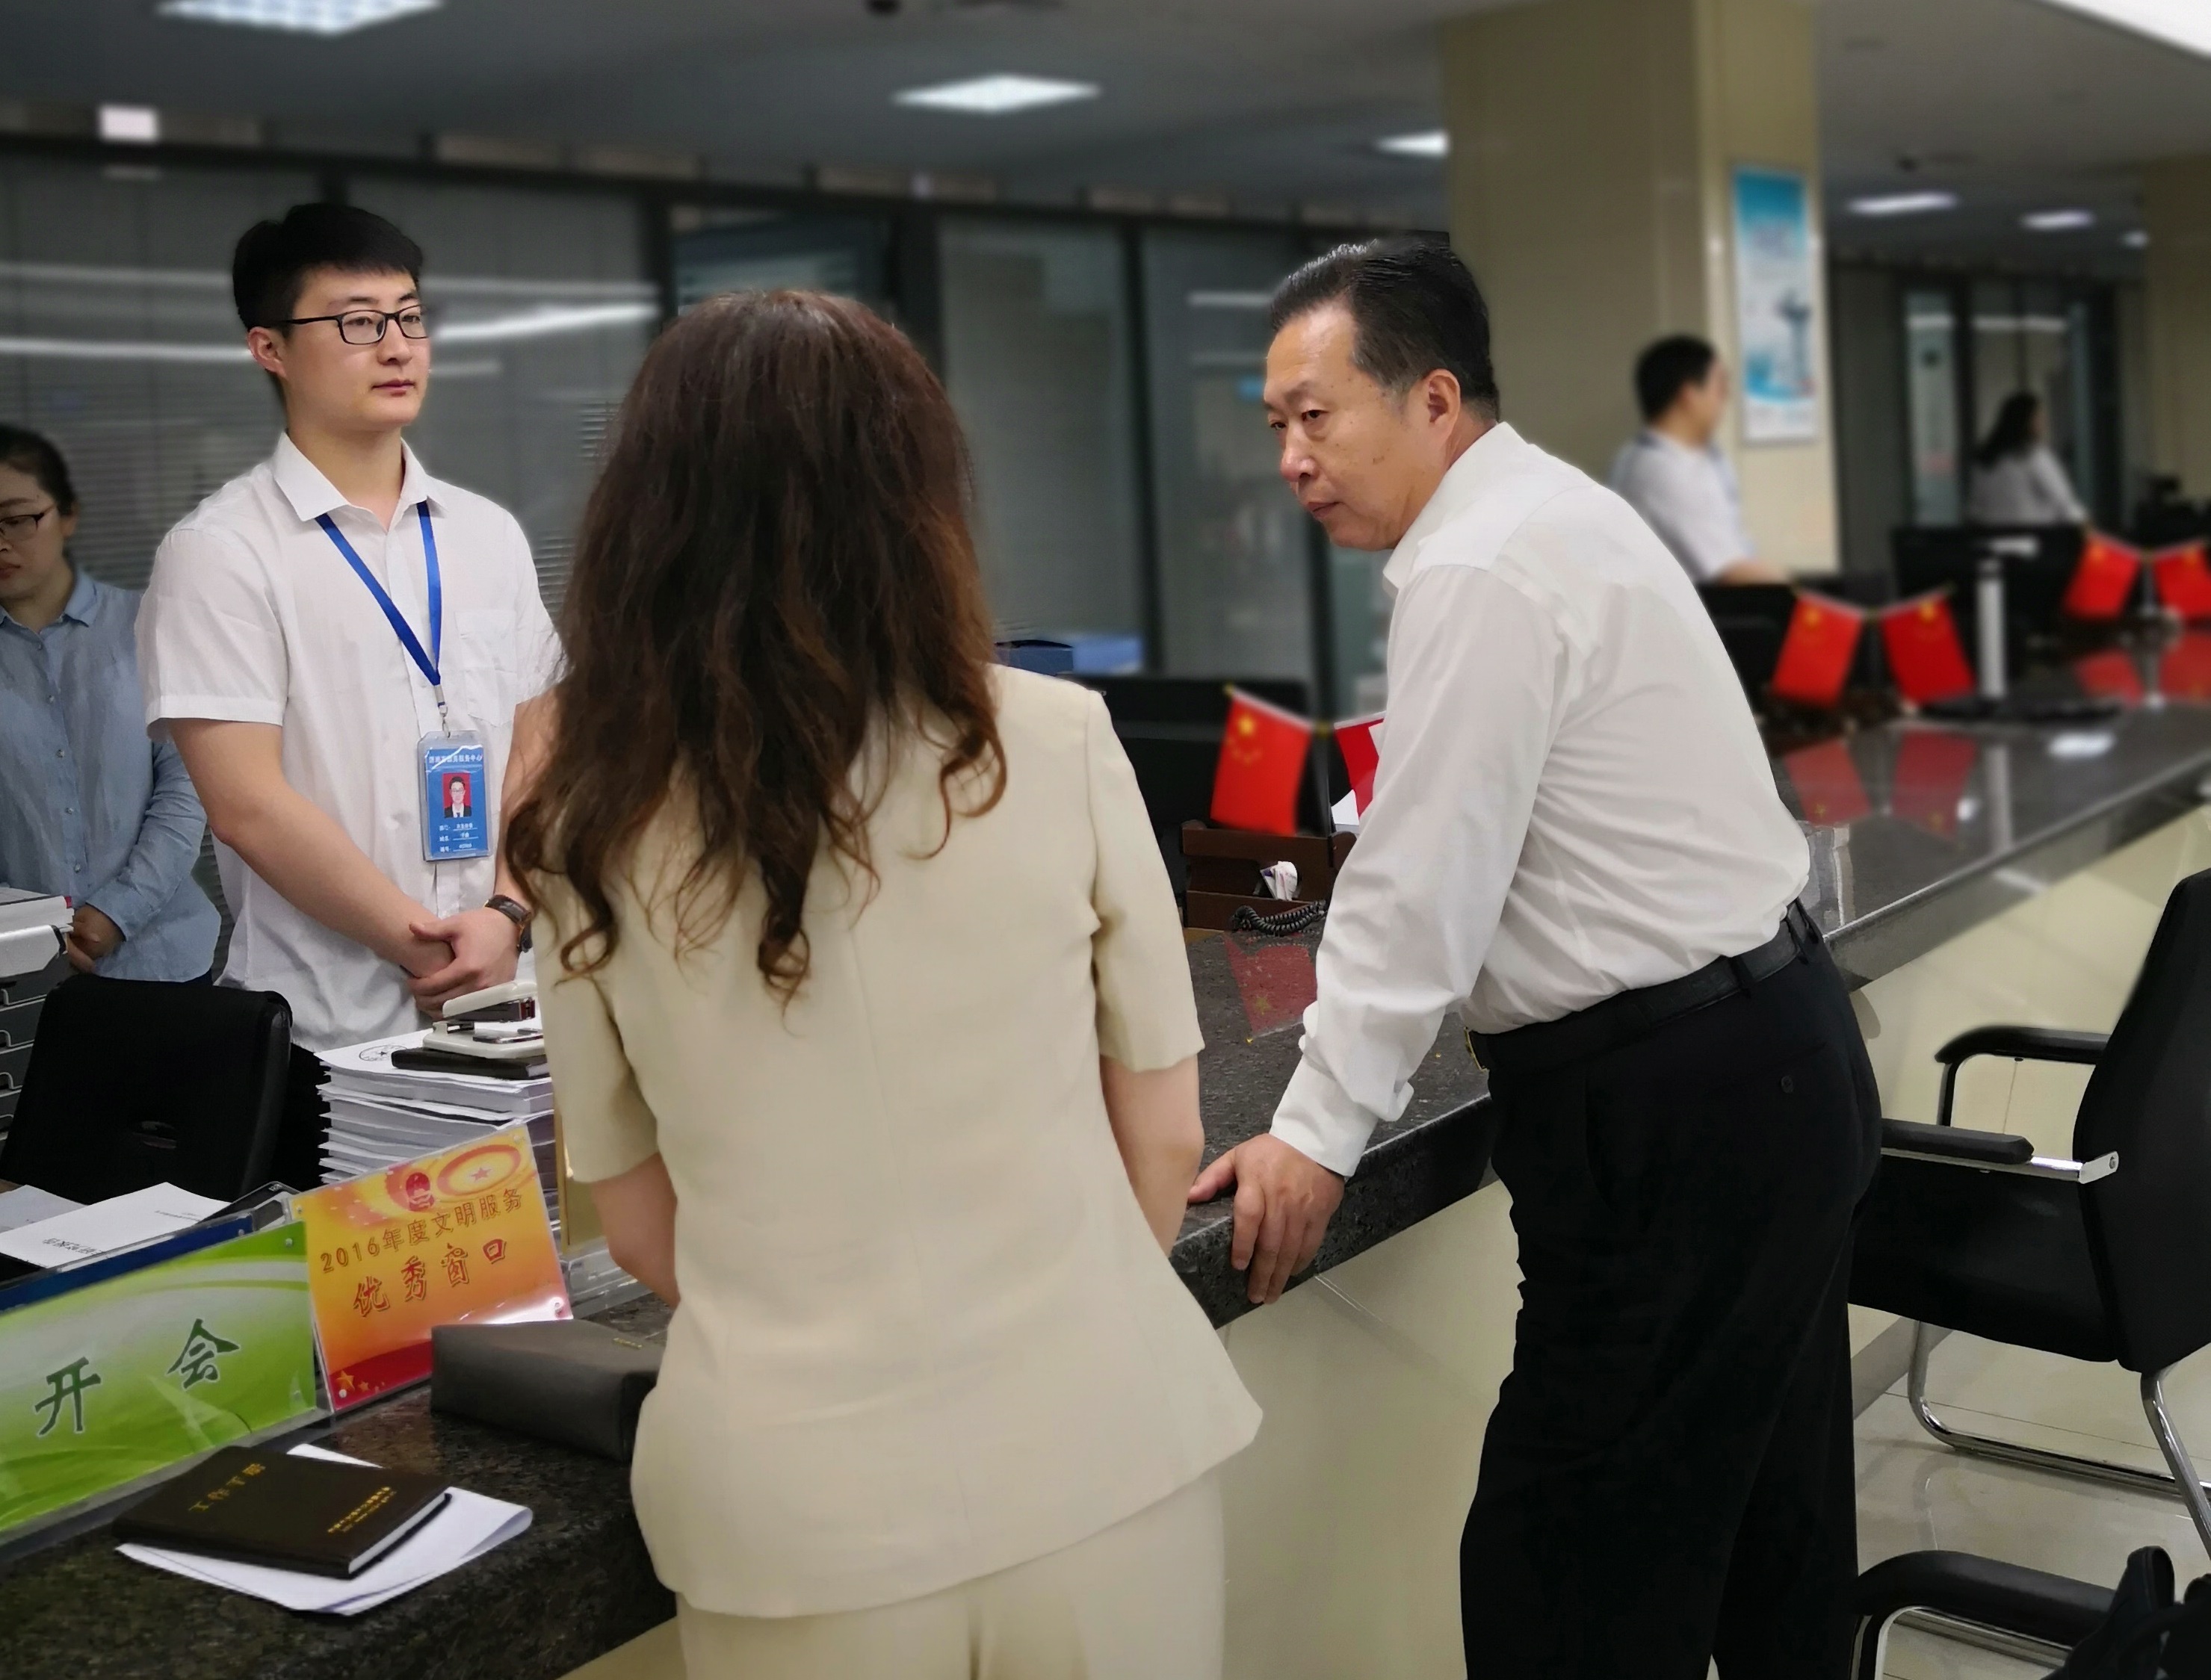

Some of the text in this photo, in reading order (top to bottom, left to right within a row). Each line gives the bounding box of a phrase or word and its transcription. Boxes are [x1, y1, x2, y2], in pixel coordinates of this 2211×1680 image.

[320, 1188, 522, 1274] 2016年度文明服务
[353, 1238, 507, 1318] 优秀窗口
[34, 1318, 241, 1436] 开会
